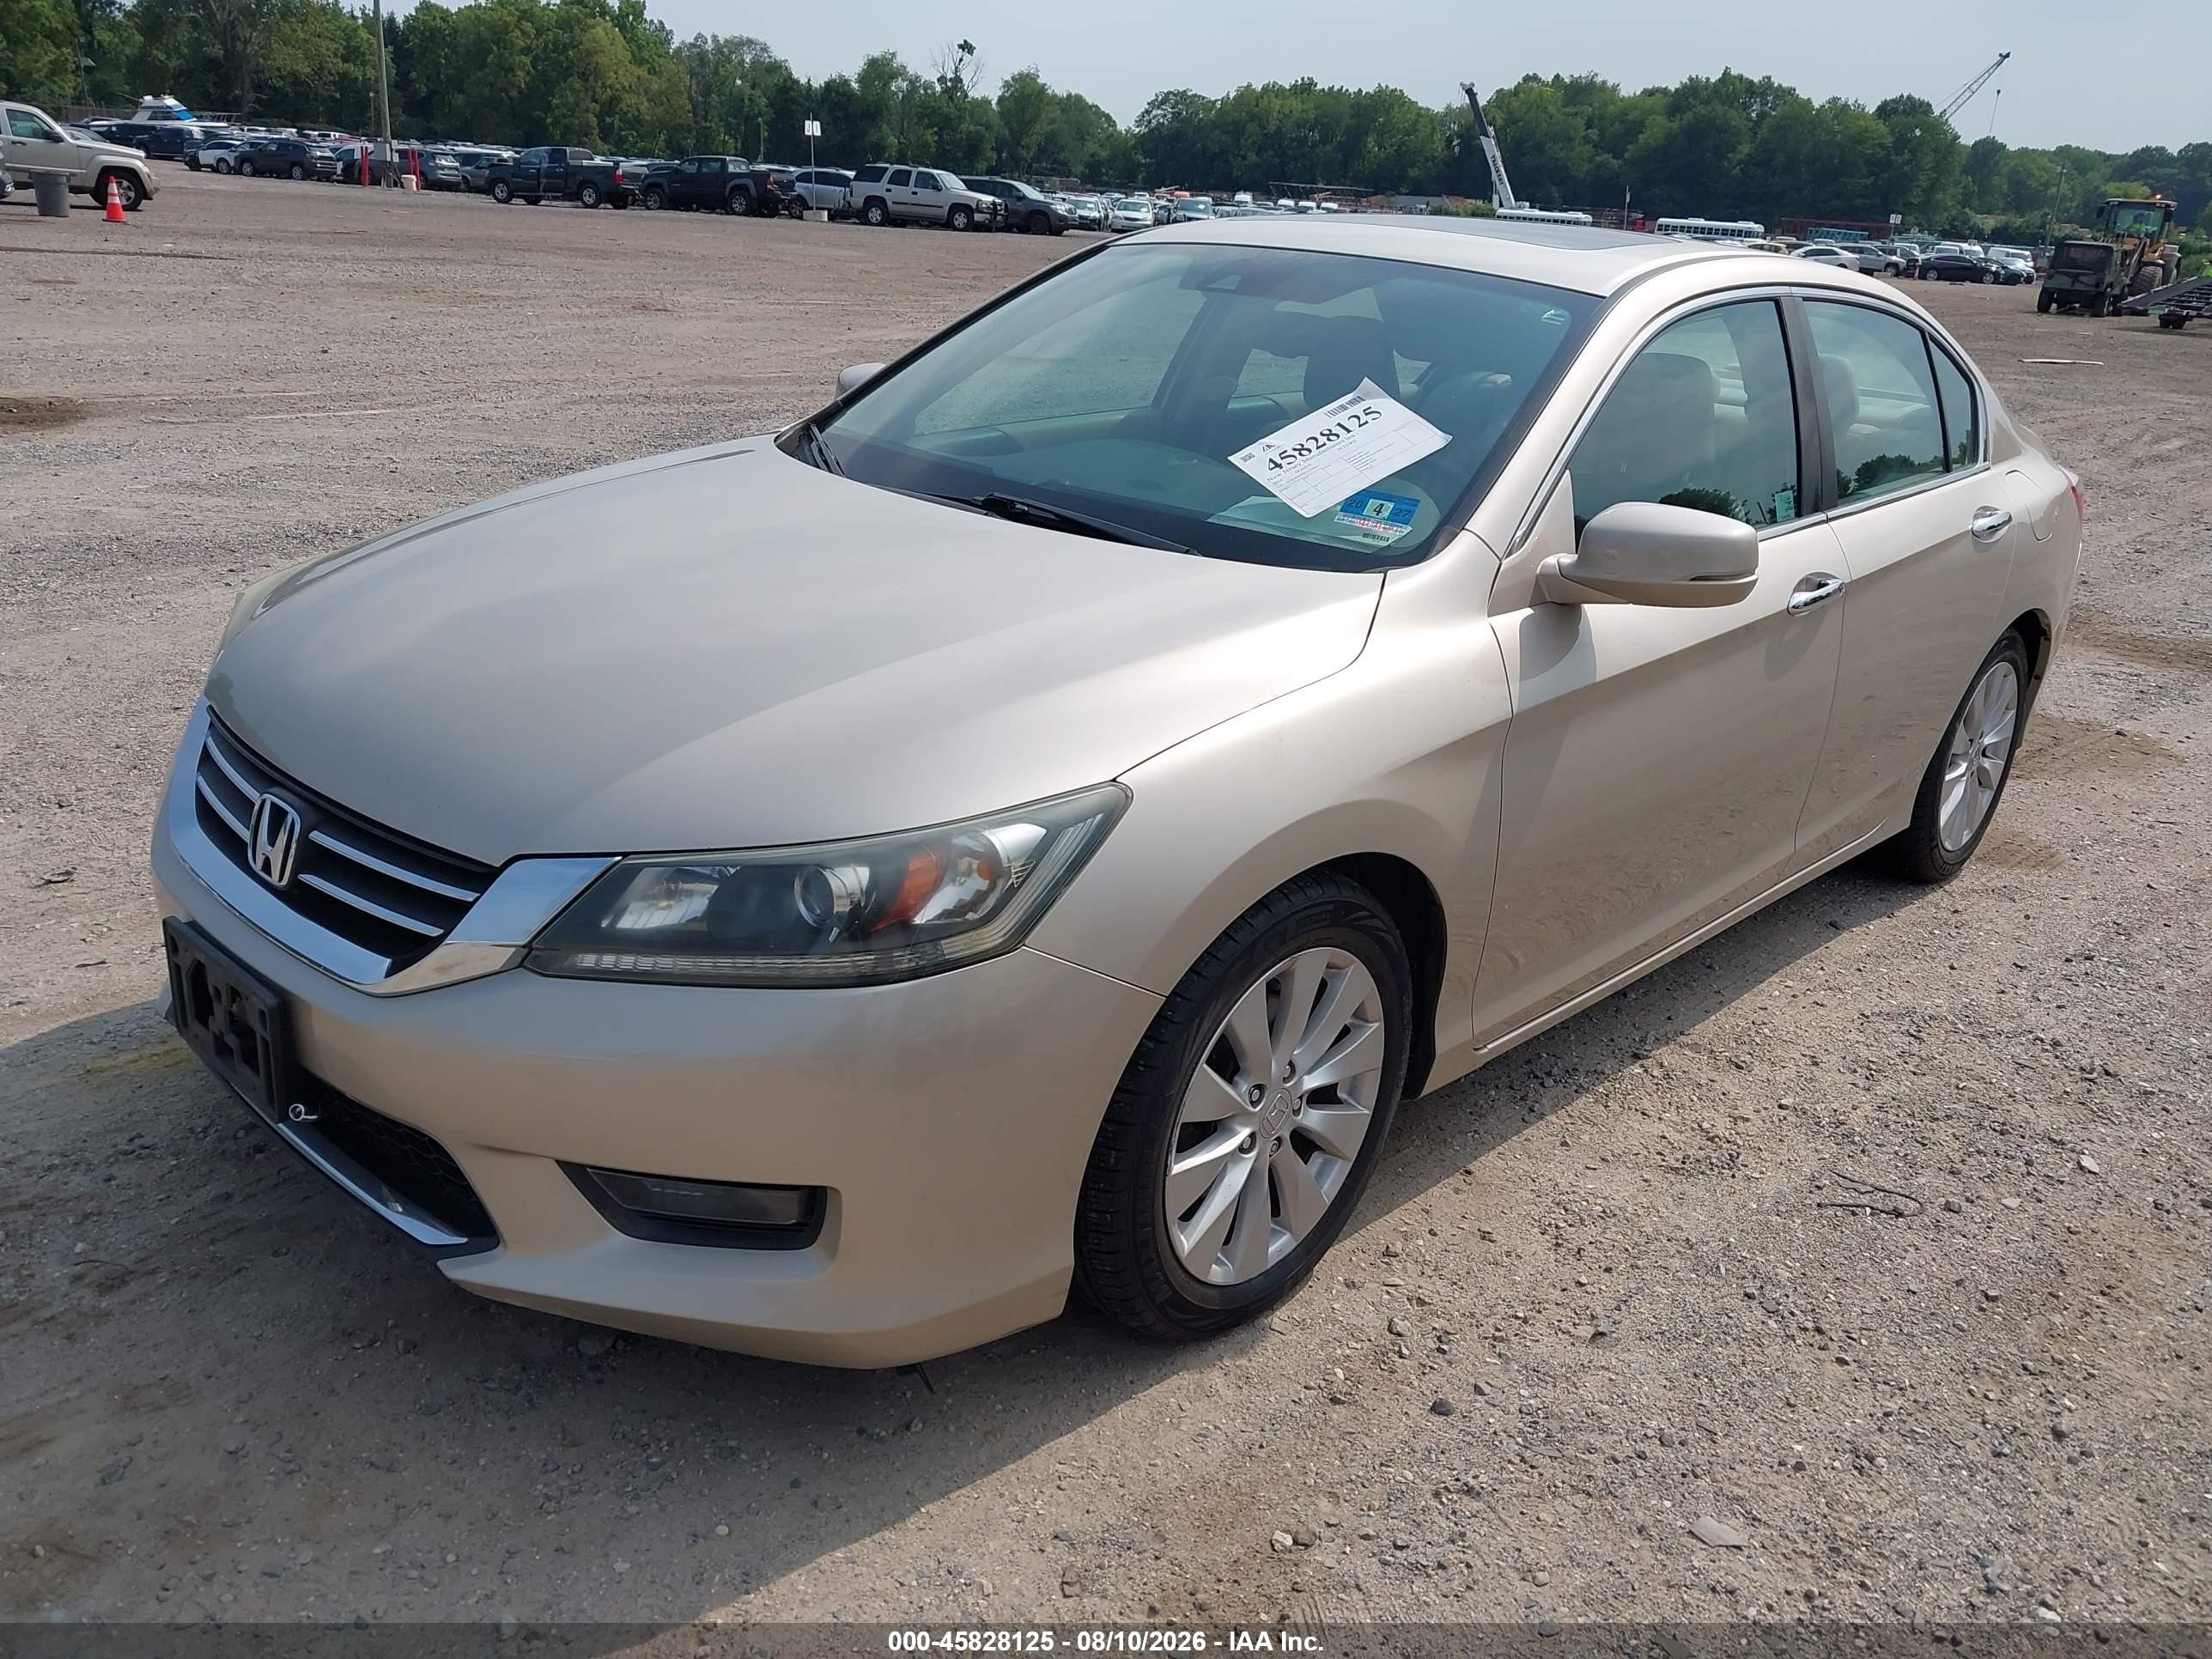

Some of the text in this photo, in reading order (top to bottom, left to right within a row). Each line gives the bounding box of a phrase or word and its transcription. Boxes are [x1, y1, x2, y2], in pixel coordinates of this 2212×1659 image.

[1267, 405, 1382, 472] 45828125
[1282, 462, 1302, 476] Jersey
[1303, 439, 1345, 465] Manufacturers
[1347, 499, 1363, 509] 20
[1373, 502, 1384, 516] 4
[1393, 507, 1411, 518] 27
